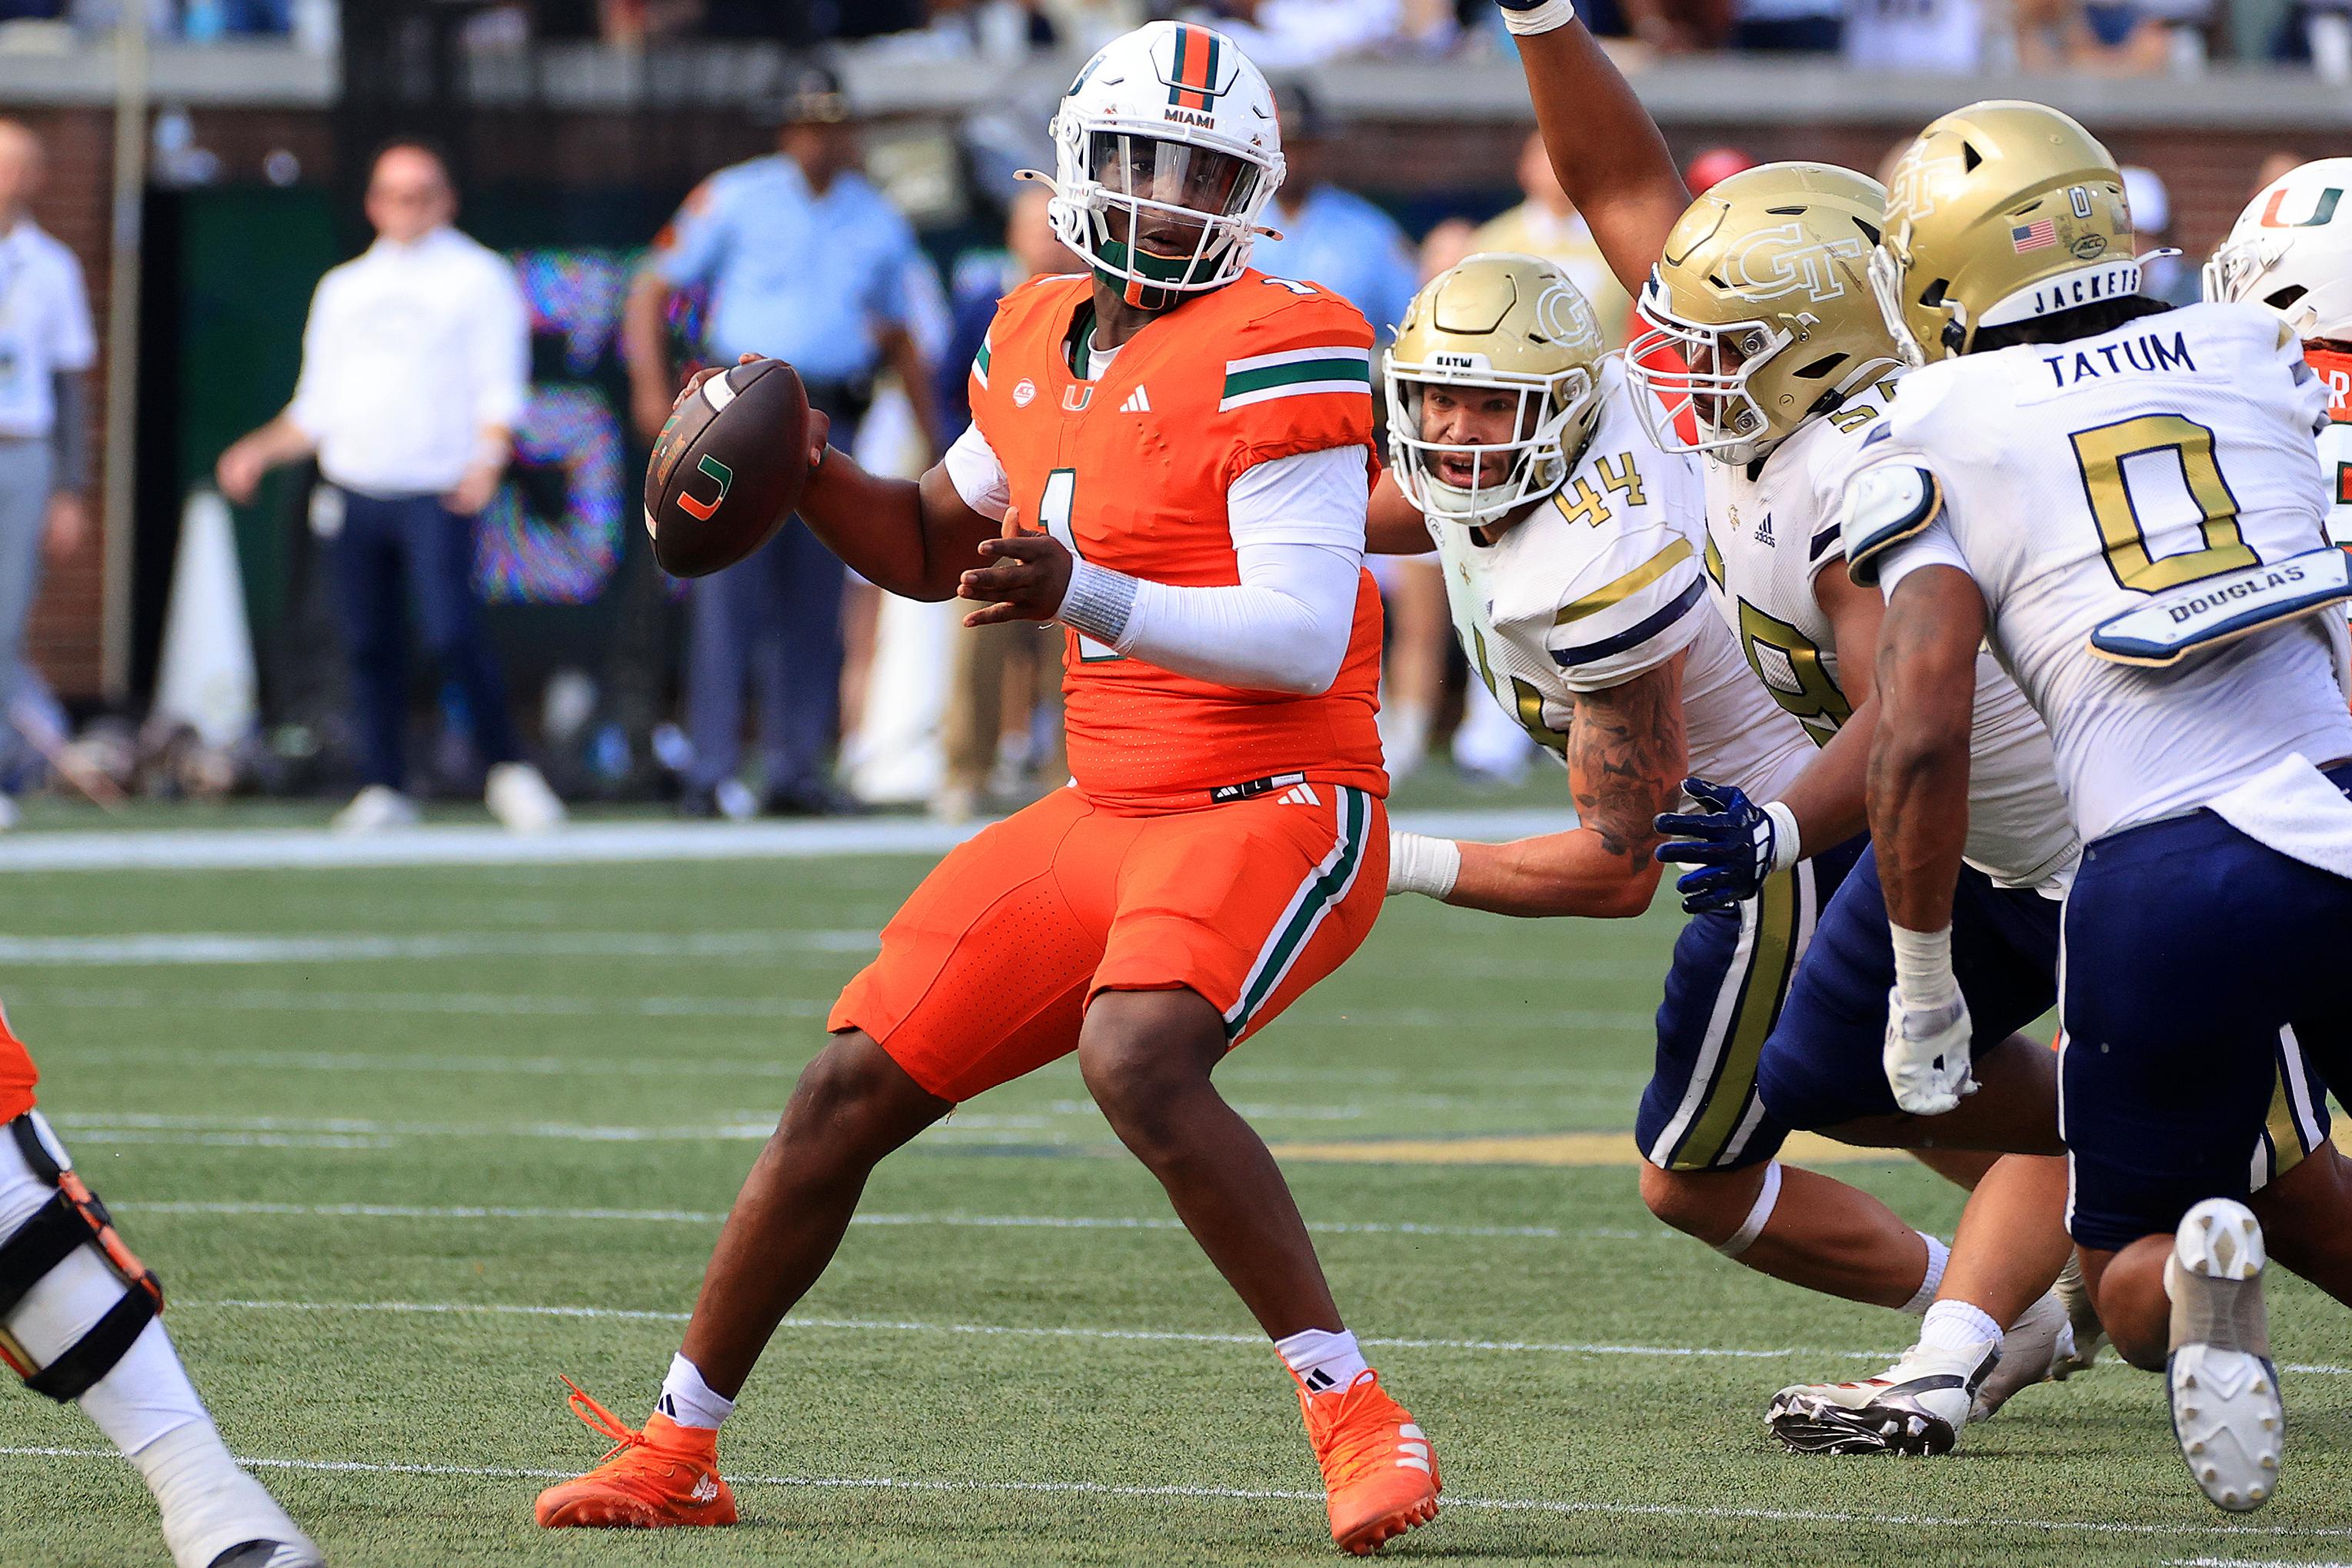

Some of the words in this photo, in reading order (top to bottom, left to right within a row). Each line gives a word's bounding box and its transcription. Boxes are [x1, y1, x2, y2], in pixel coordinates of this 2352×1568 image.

[1164, 108, 1215, 130] MIAMI
[2260, 188, 2344, 228] U
[1722, 223, 1864, 303] GT
[2035, 268, 2137, 313] JACKETS
[2043, 331, 2197, 388] TATUM
[1062, 385, 1094, 411] U
[677, 454, 732, 521] U
[1553, 452, 1647, 528] 44
[2068, 413, 2264, 596] 0
[2168, 566, 2306, 624] DOUGLAS
